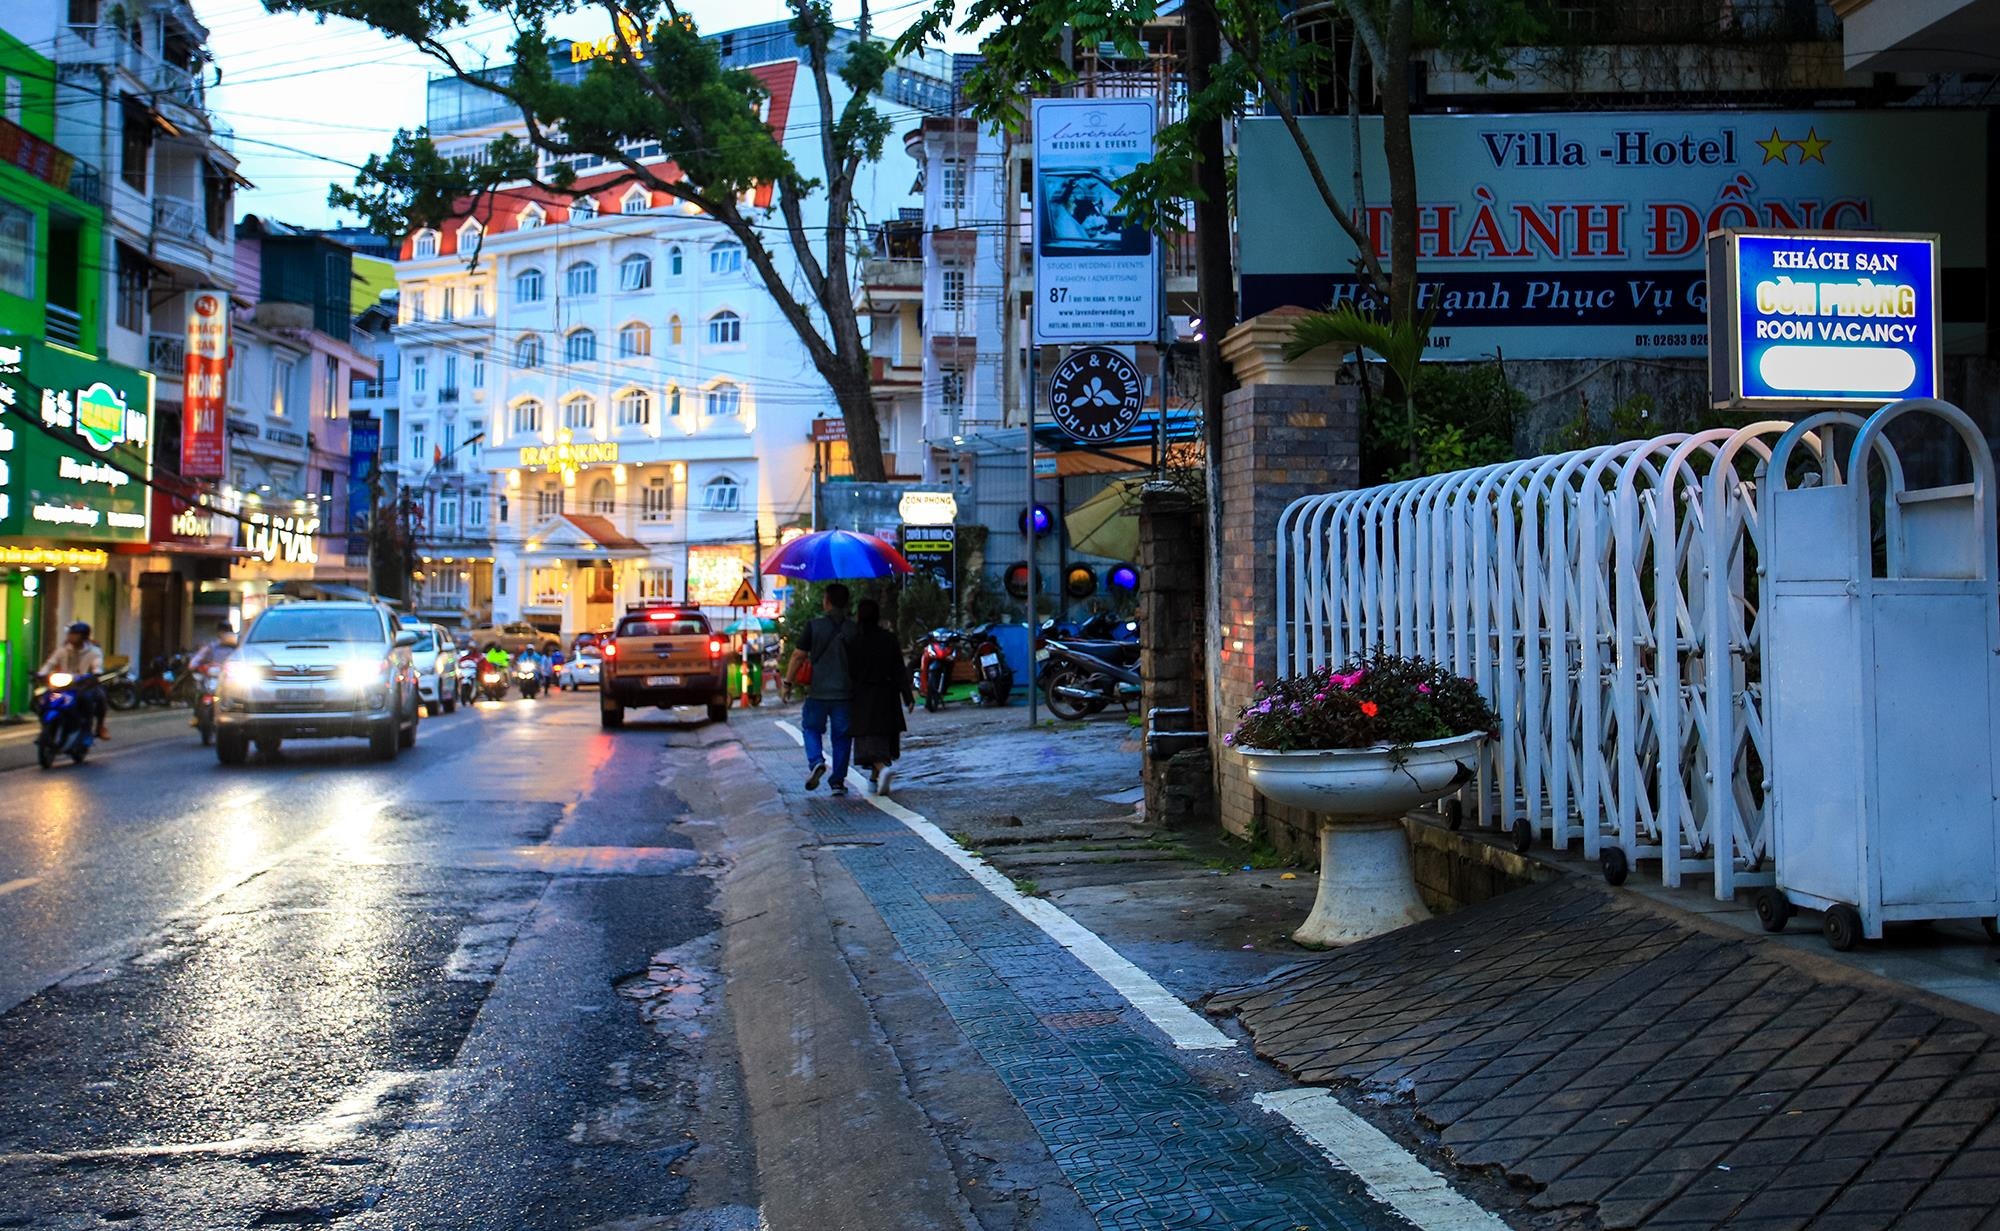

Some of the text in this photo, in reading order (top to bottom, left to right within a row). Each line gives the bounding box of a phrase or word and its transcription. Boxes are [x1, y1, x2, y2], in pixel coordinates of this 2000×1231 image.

[1042, 122, 1147, 141] lavender
[1052, 140, 1137, 149] WEDDING & EVENTS
[1482, 131, 1586, 166] Villa
[1047, 261, 1144, 270] STUDIO WEDDING EVENTS
[1773, 247, 1898, 274] KHÁCH SẠN
[1055, 274, 1138, 282] FASHION ADVERTISING
[1050, 287, 1068, 303] 87
[1522, 281, 1615, 317] Phục
[1628, 280, 1673, 315] Vụ
[1757, 320, 1917, 342] ROOM VACANCY
[1054, 354, 1138, 437] HOSTEL & HOMESTAY
